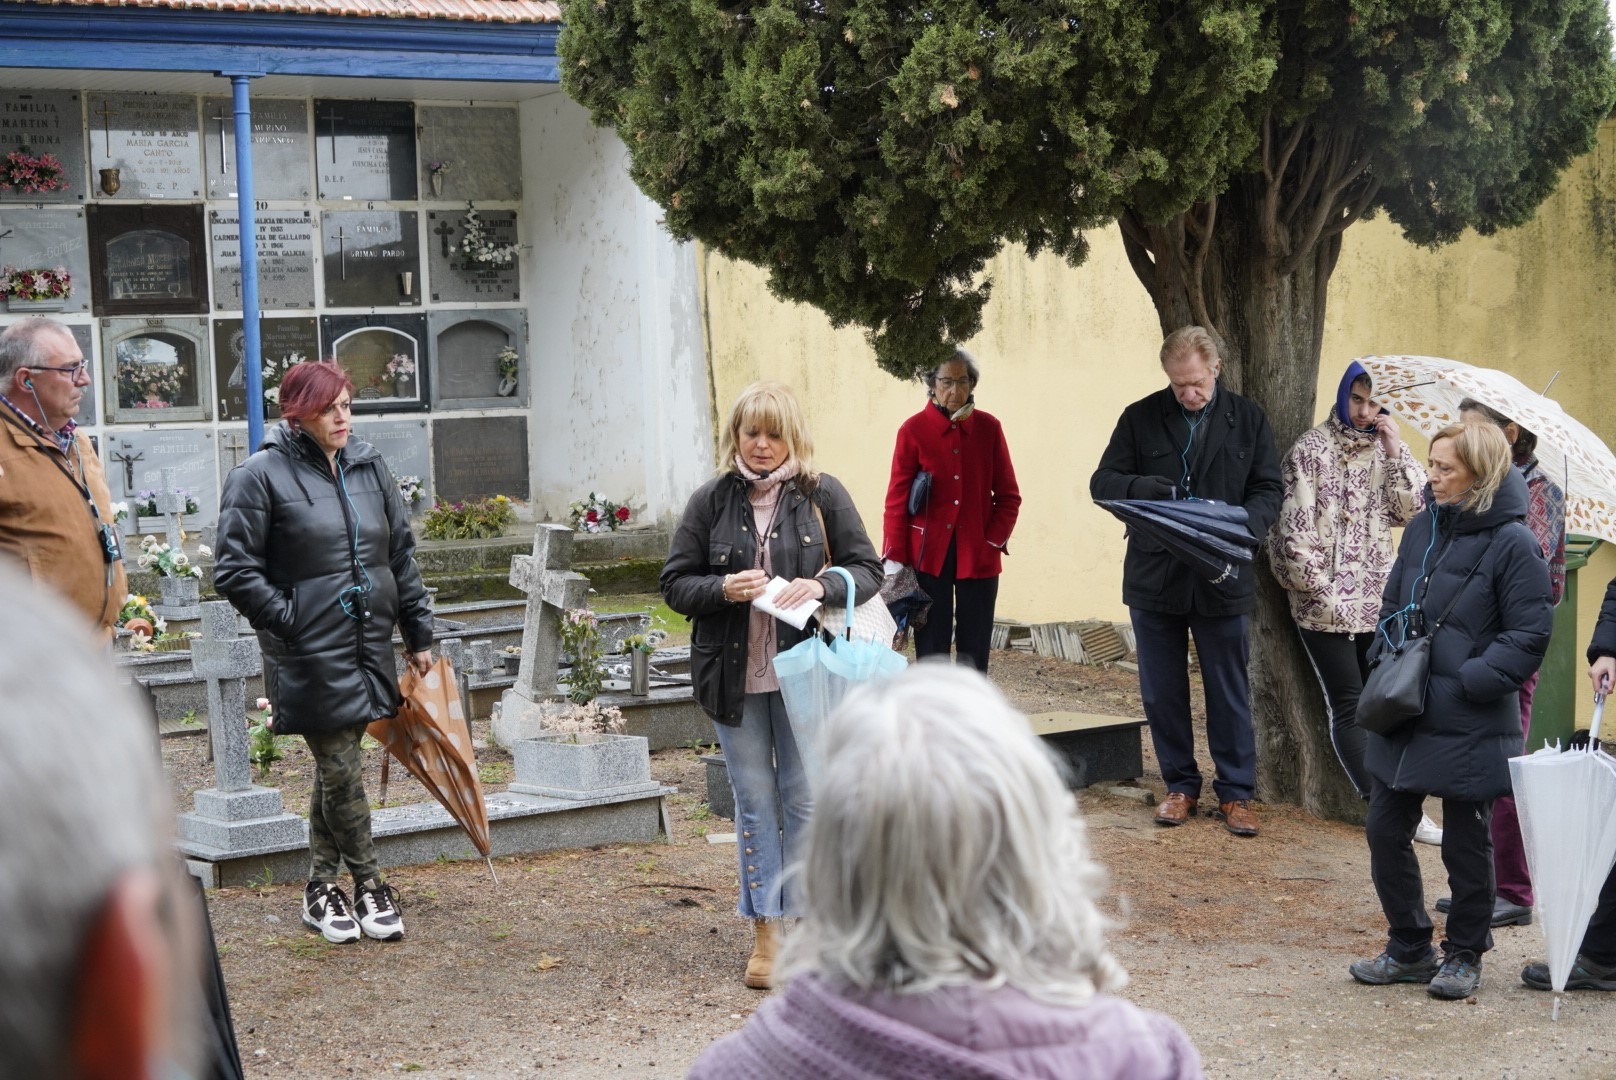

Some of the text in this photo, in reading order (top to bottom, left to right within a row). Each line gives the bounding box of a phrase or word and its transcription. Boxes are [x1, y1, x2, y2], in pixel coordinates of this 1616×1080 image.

[5, 103, 57, 112] FAMILIA
[2, 119, 48, 128] MARTIN
[126, 139, 190, 148] MARIA GARCIA
[143, 149, 173, 157] CANTO
[256, 201, 268, 210] 10
[367, 202, 374, 211] 6
[351, 249, 405, 258] GRIMAU PARDO
[369, 431, 413, 440] FAMILIA
[152, 444, 200, 454] FAMILIA
